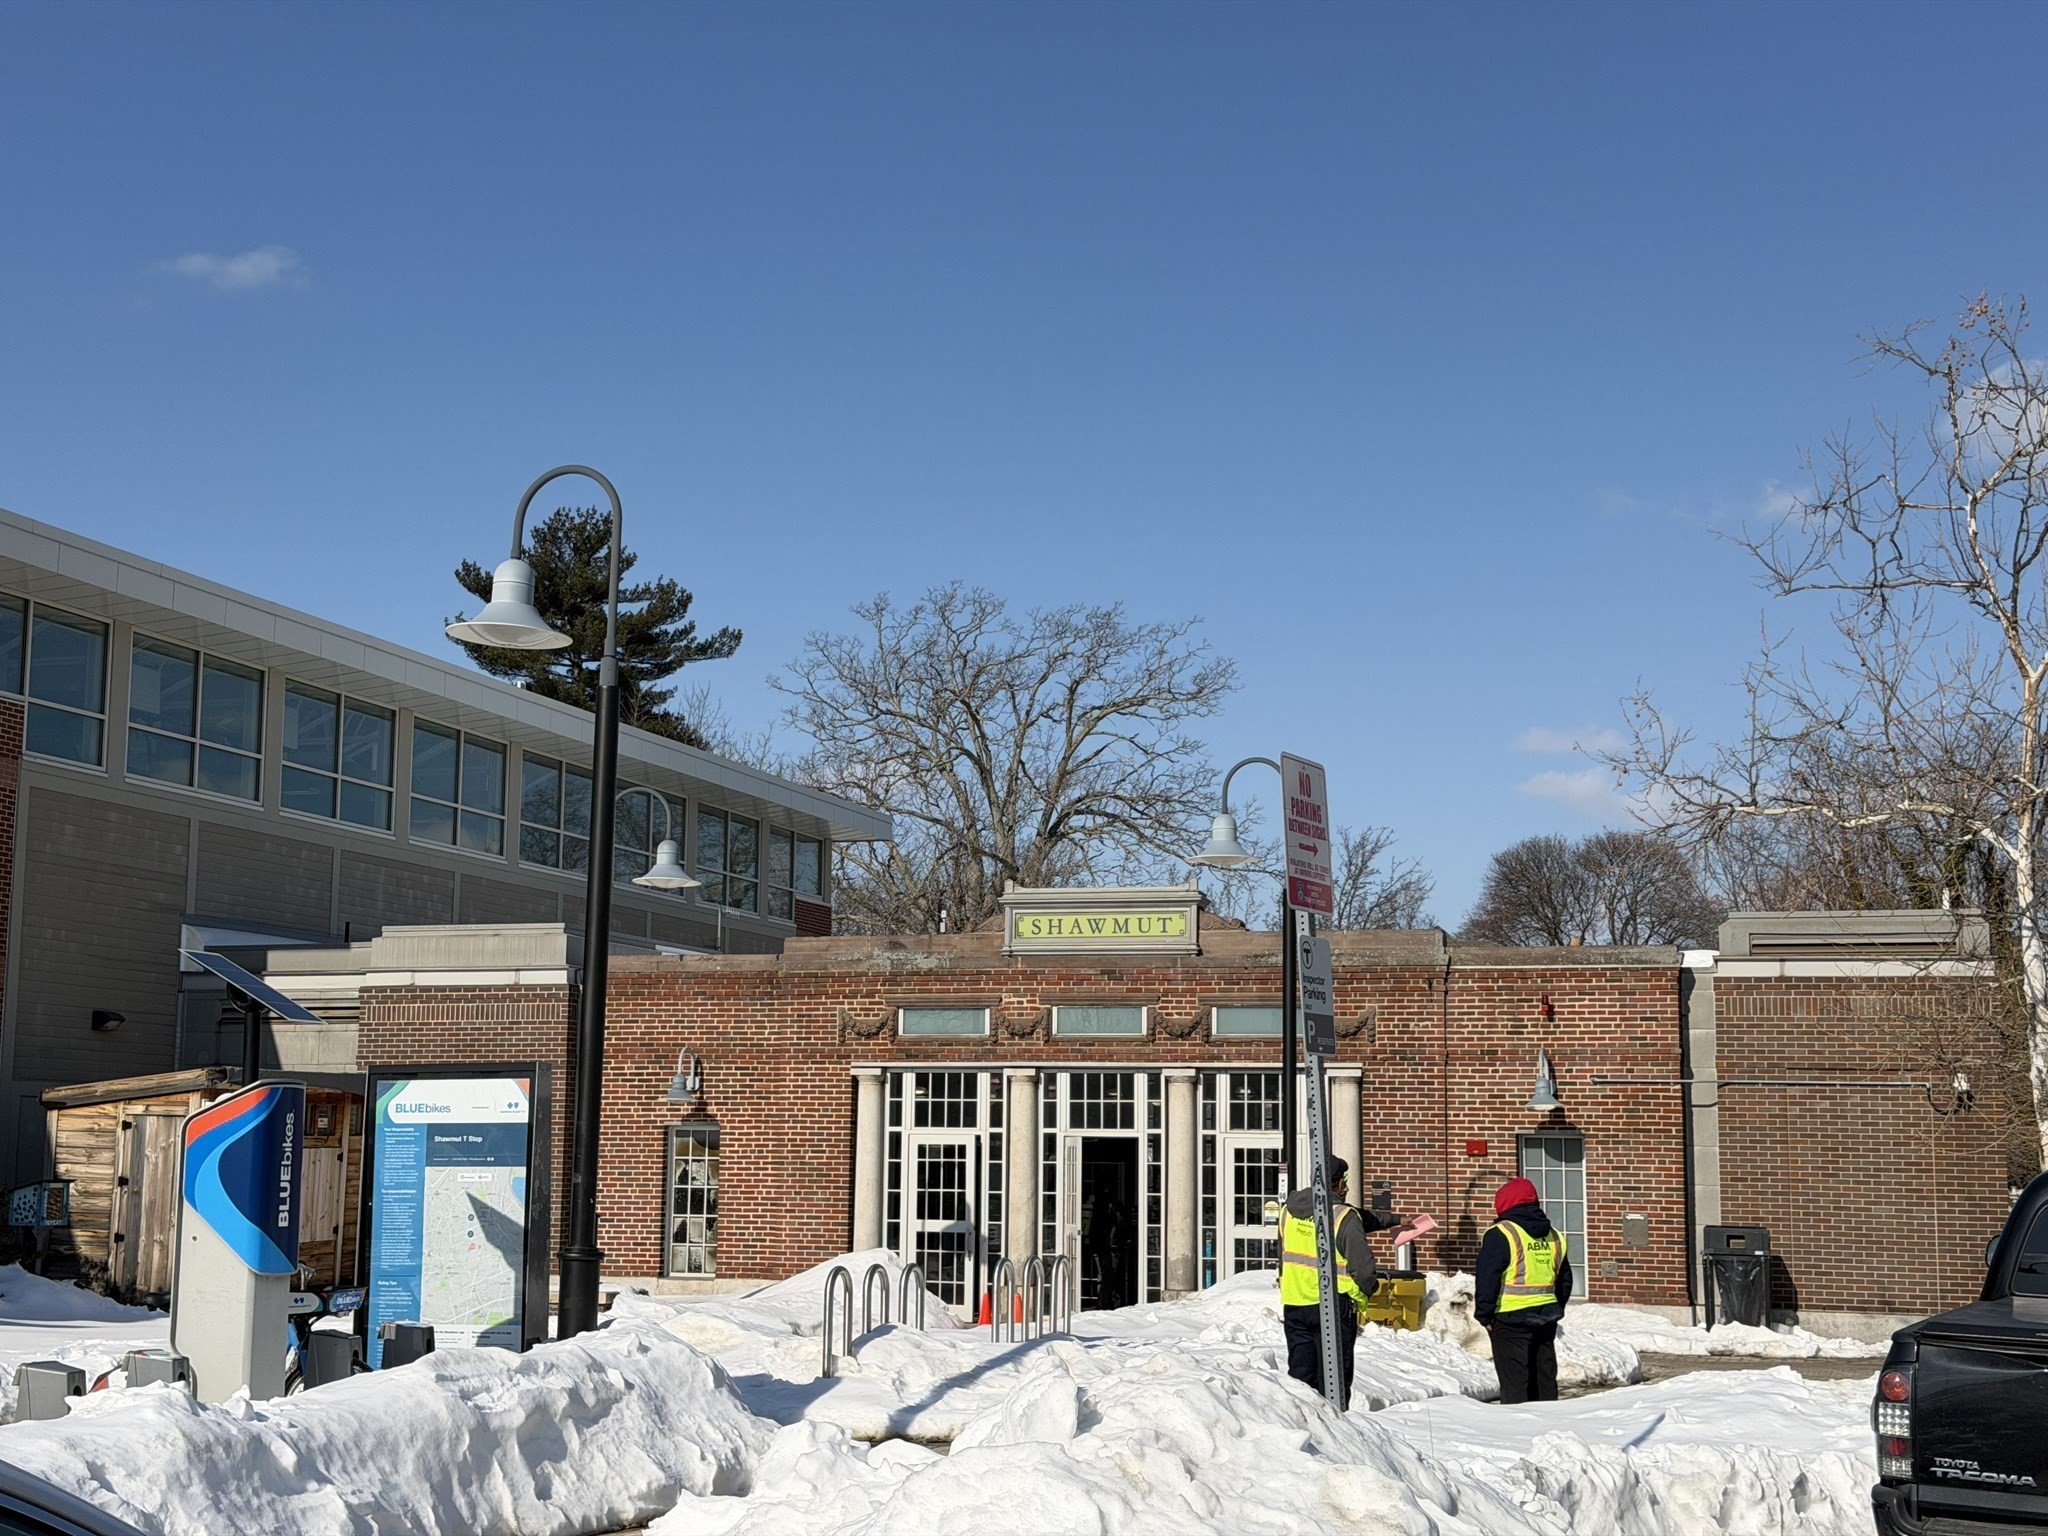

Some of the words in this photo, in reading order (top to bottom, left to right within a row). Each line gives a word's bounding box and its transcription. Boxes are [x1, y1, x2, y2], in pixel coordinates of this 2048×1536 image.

[1299, 771, 1311, 798] NO
[1290, 796, 1322, 823] PARKING
[1288, 817, 1311, 837] BETWEEN
[1031, 917, 1173, 935] SHAWMUT
[1303, 948, 1311, 964] T
[1303, 973, 1325, 986] Inspector
[1303, 986, 1327, 1004] Parking
[1307, 1020, 1316, 1044] P
[395, 1103, 451, 1114] BLUEbikes
[434, 1135, 461, 1143] Shawmut
[461, 1135, 467, 1143] T
[468, 1135, 483, 1144] Stop
[278, 1112, 295, 1228] BLUEbikes
[1527, 1242, 1551, 1251] ABM
[1934, 1457, 1980, 1470] TOYOTA
[1929, 1467, 2037, 1487] TACOMA
